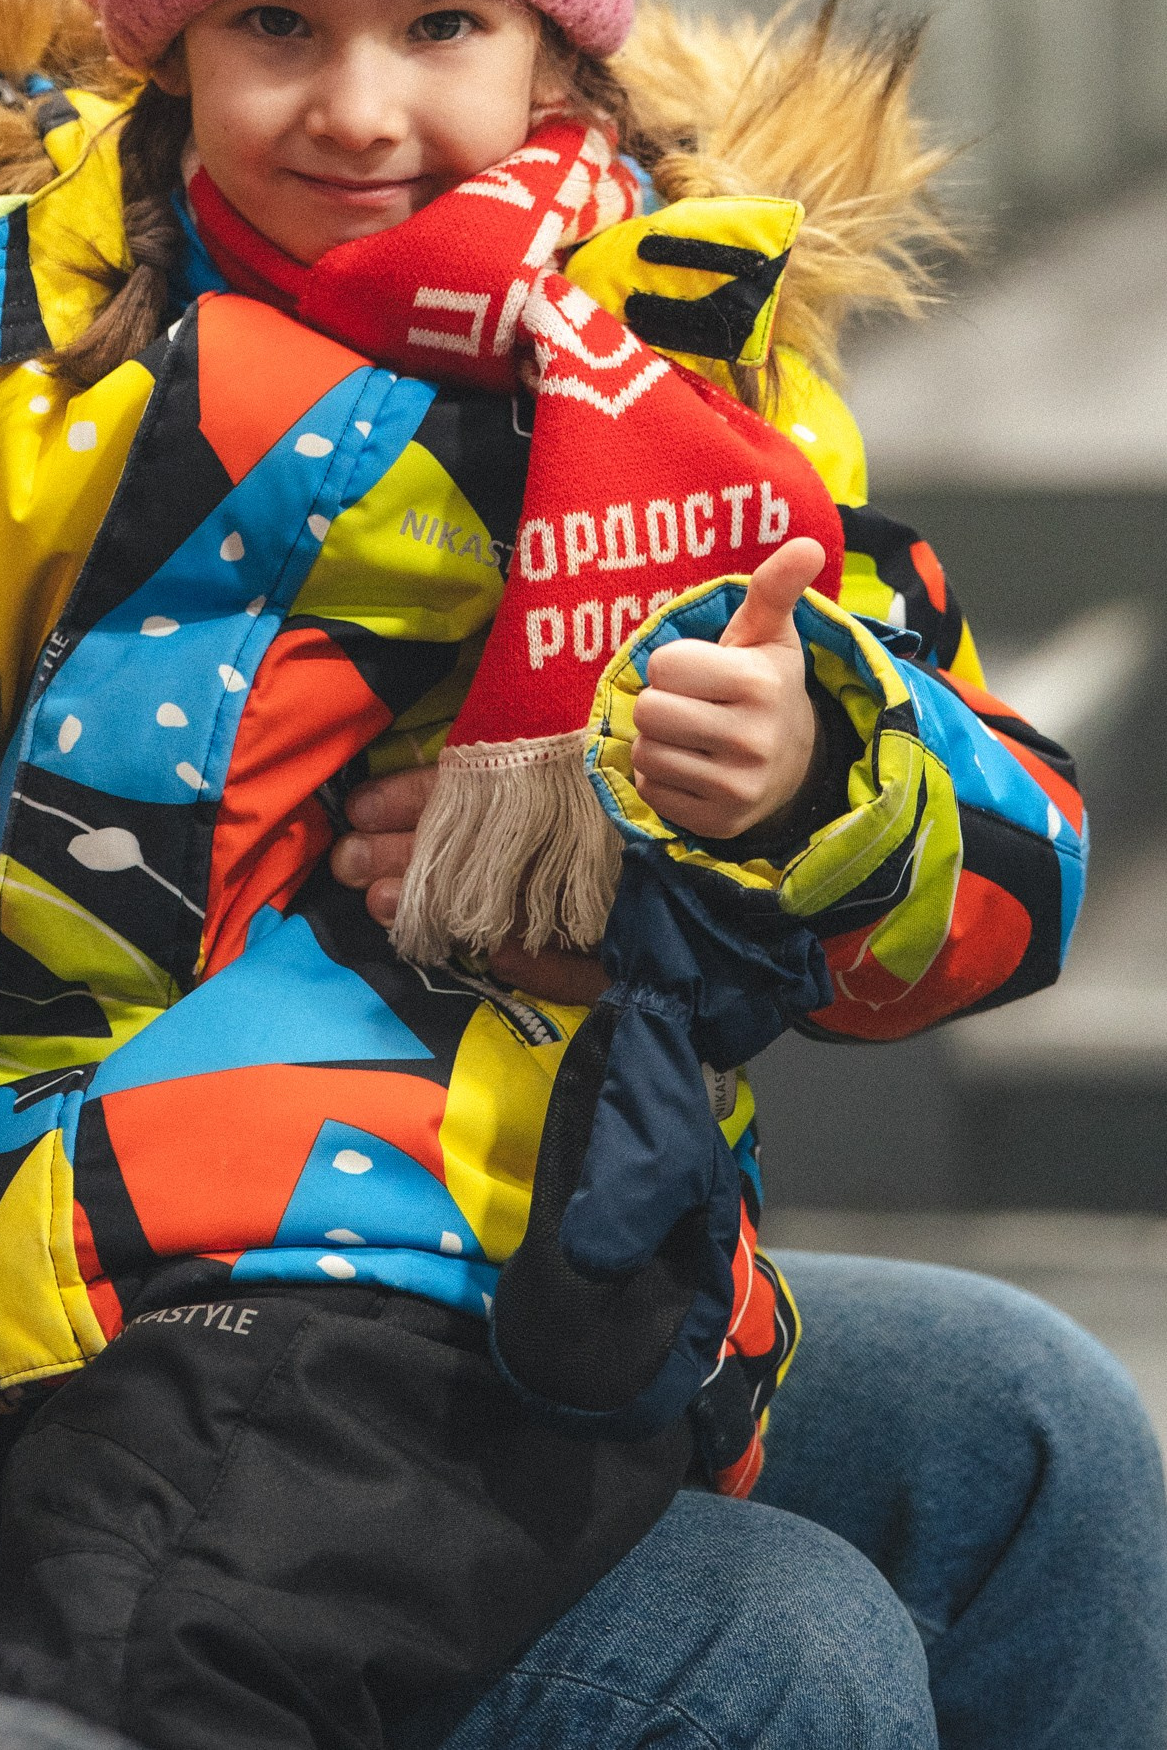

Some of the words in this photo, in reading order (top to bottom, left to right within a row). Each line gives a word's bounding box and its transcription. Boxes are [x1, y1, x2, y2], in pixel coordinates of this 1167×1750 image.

[518, 480, 790, 583] ОРДОСТЬ
[526, 586, 692, 670] РОС
[714, 1071, 727, 1118] NIKAS
